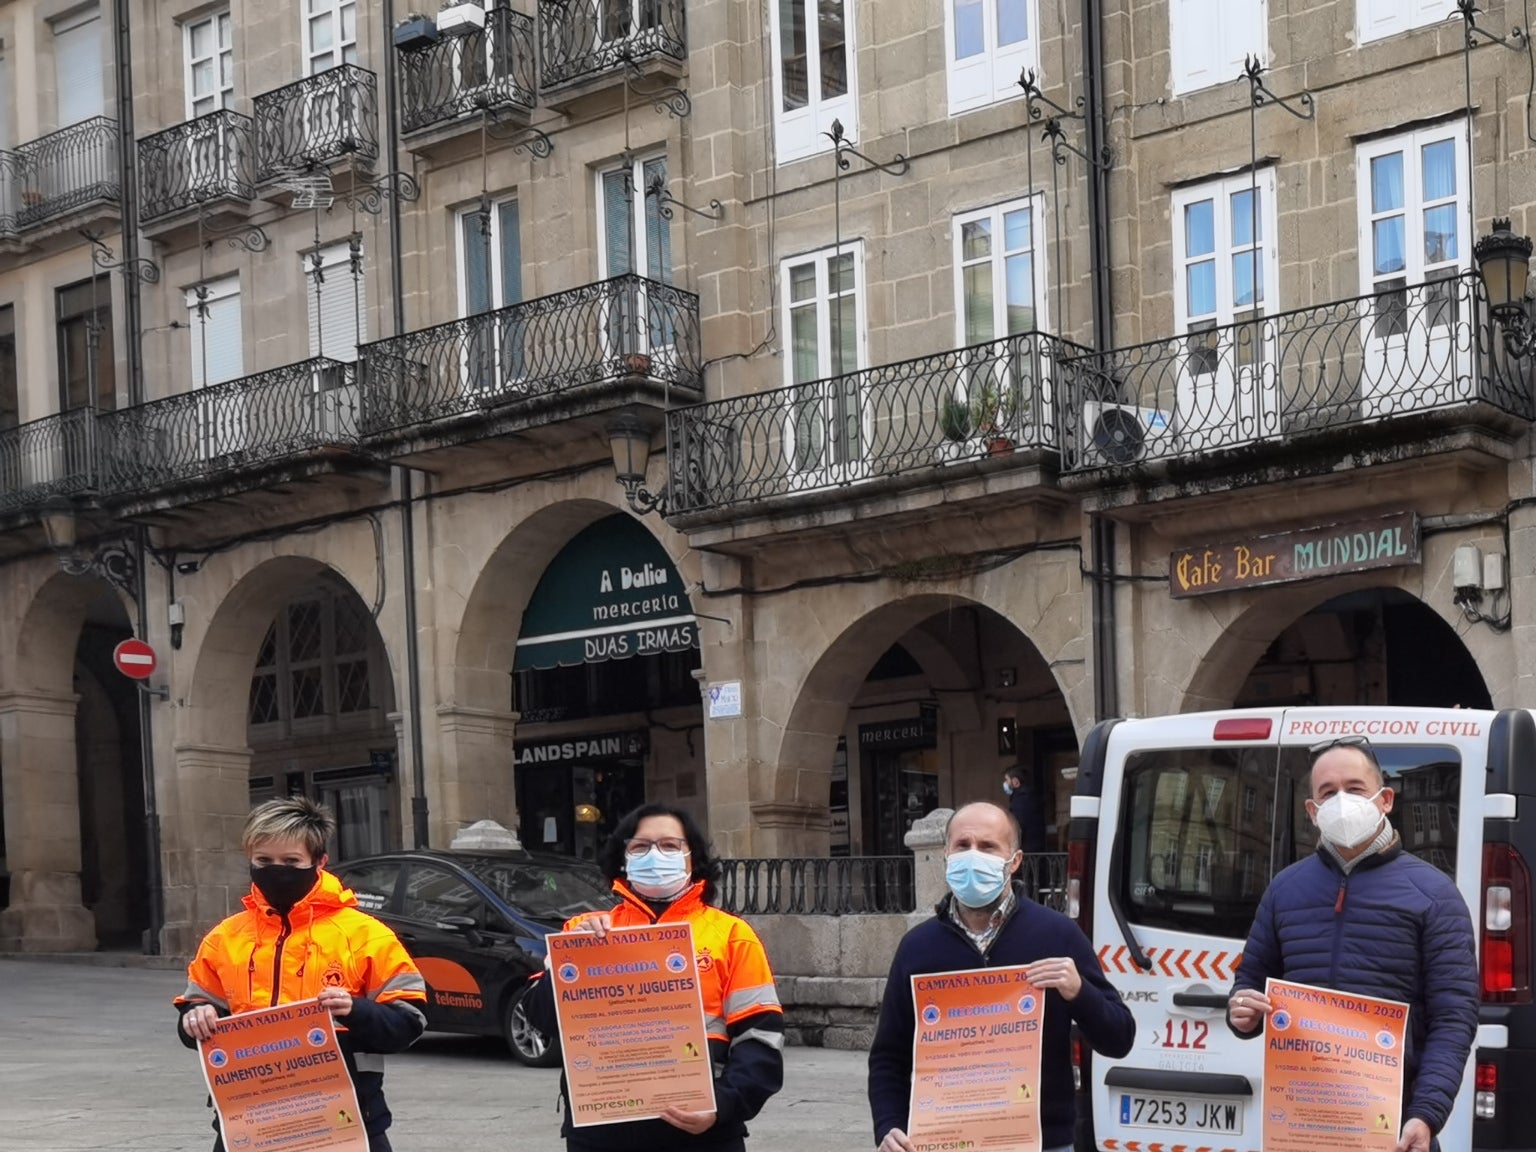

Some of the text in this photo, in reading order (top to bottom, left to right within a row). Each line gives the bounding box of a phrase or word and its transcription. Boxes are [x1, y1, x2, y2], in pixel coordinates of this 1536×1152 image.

[1176, 528, 1408, 591] Café Bar MUNDIAL
[600, 563, 667, 592] A Dalia
[585, 627, 691, 658] DUAS IRMAS
[1289, 721, 1481, 736] PROTECCION CIVIL
[613, 932, 653, 945] NADAL
[658, 929, 688, 941] 2020
[586, 960, 659, 977] RECOGIDA
[562, 978, 694, 1002] ALIMENTOS Y JUGUETES
[917, 975, 970, 991] CAMPAÑA
[973, 974, 1010, 986] NADAL
[435, 992, 482, 1008] telemiño
[946, 1003, 1012, 1018] RECOGIDA
[1271, 985, 1403, 1019] CAMPAÑA NADAL 2020
[256, 1011, 294, 1027] NADAL
[921, 1019, 1038, 1042] ALIMENTOS Y JUGUETES
[1299, 1018, 1369, 1040] RECOGIDA
[1162, 1019, 1208, 1049] 112
[234, 1038, 302, 1060] RECOGIDA
[1270, 1038, 1398, 1067] ALIMENTOS Y JUGUETES
[215, 1050, 338, 1086] ALIMENTOS Y JUGUETES
[1134, 1098, 1187, 1126] 7253
[1196, 1104, 1236, 1130] JKW
